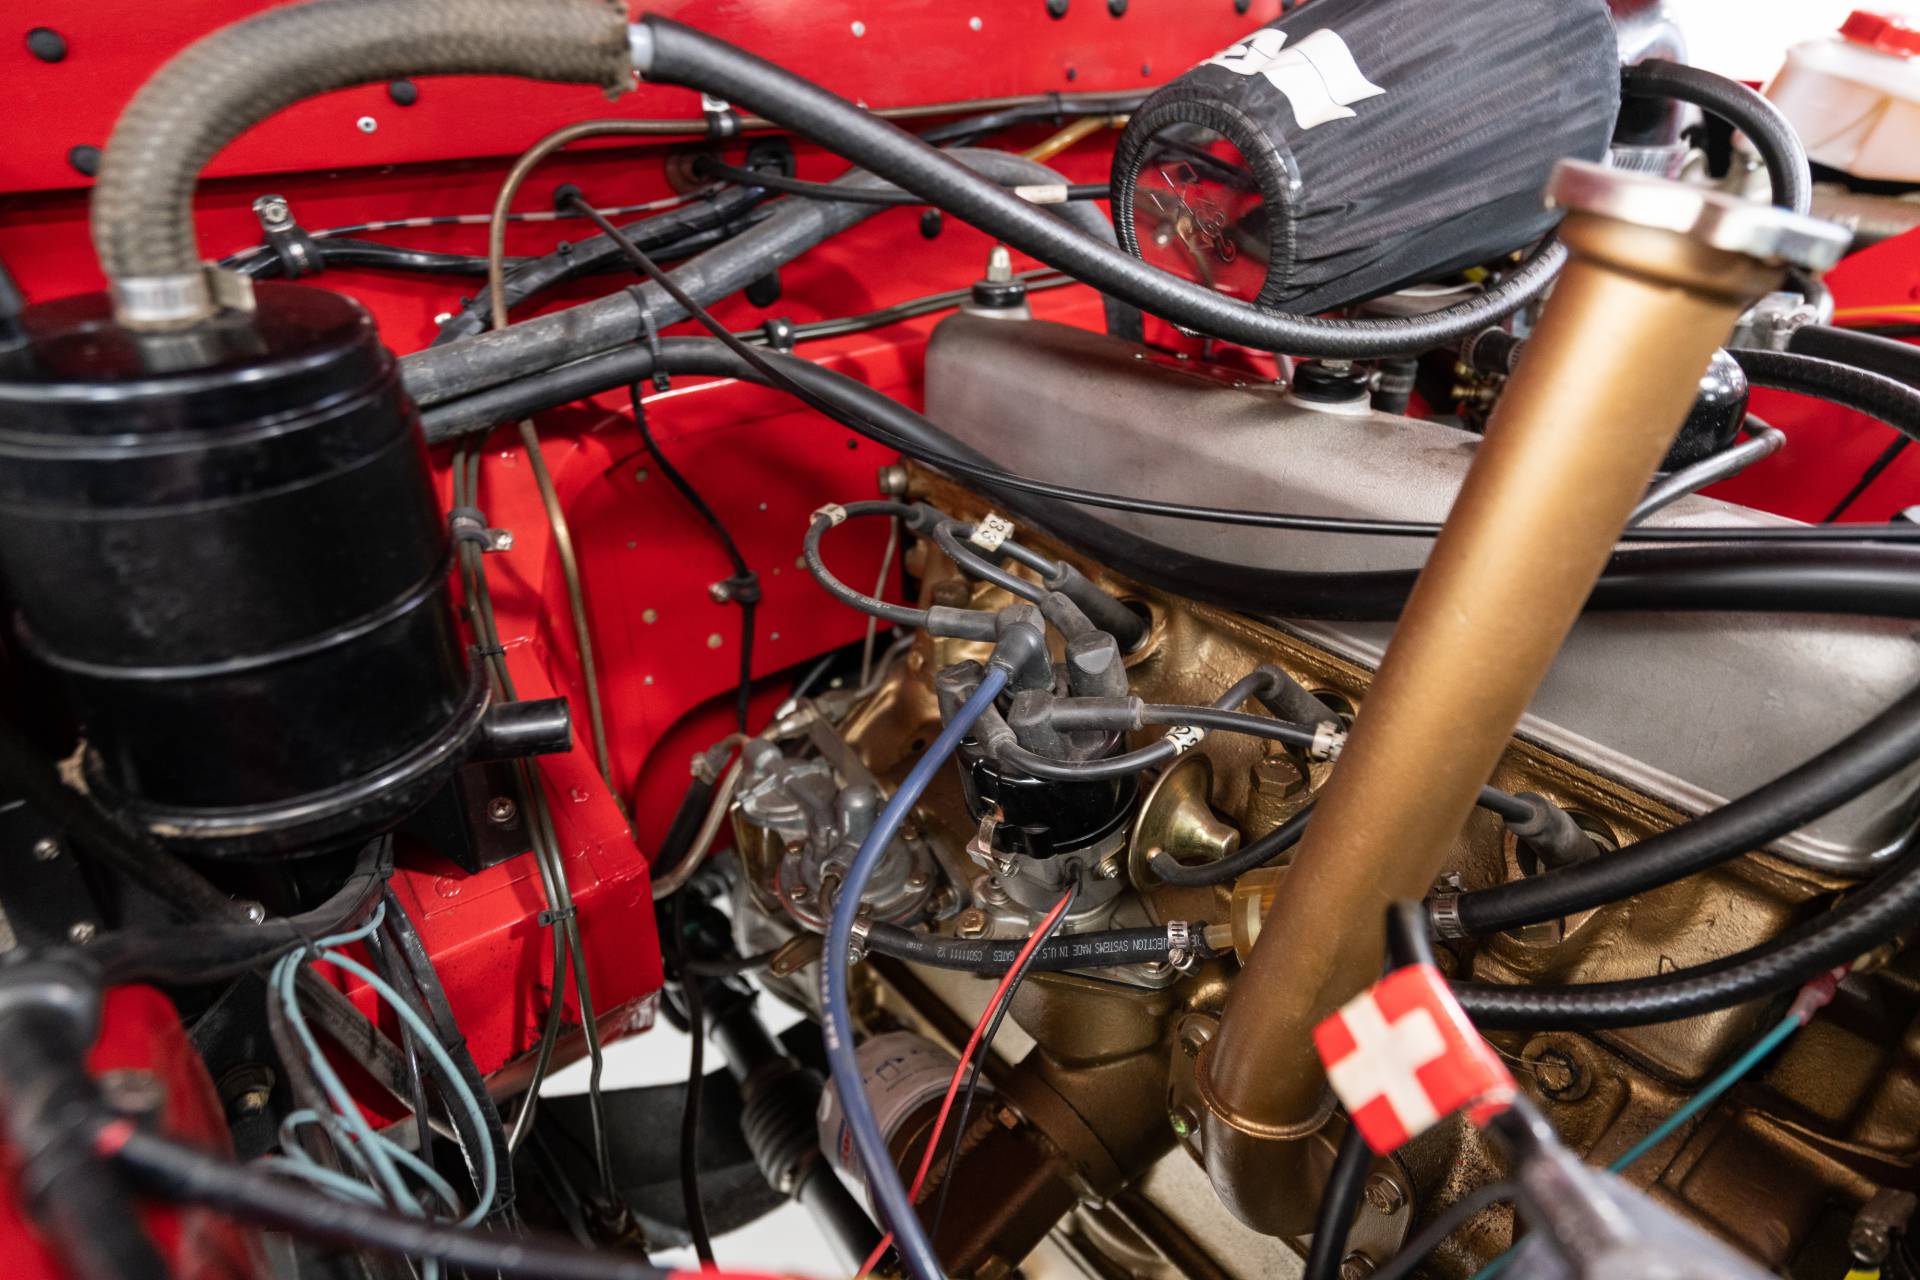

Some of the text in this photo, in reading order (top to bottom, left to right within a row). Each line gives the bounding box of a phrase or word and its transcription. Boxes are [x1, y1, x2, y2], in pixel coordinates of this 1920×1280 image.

[1072, 944, 1092, 956] MADE
[1095, 940, 1129, 954] SYSTEMS
[1132, 936, 1170, 952] JECTION
[993, 950, 1015, 962] GATES
[1059, 946, 1069, 959] IN
